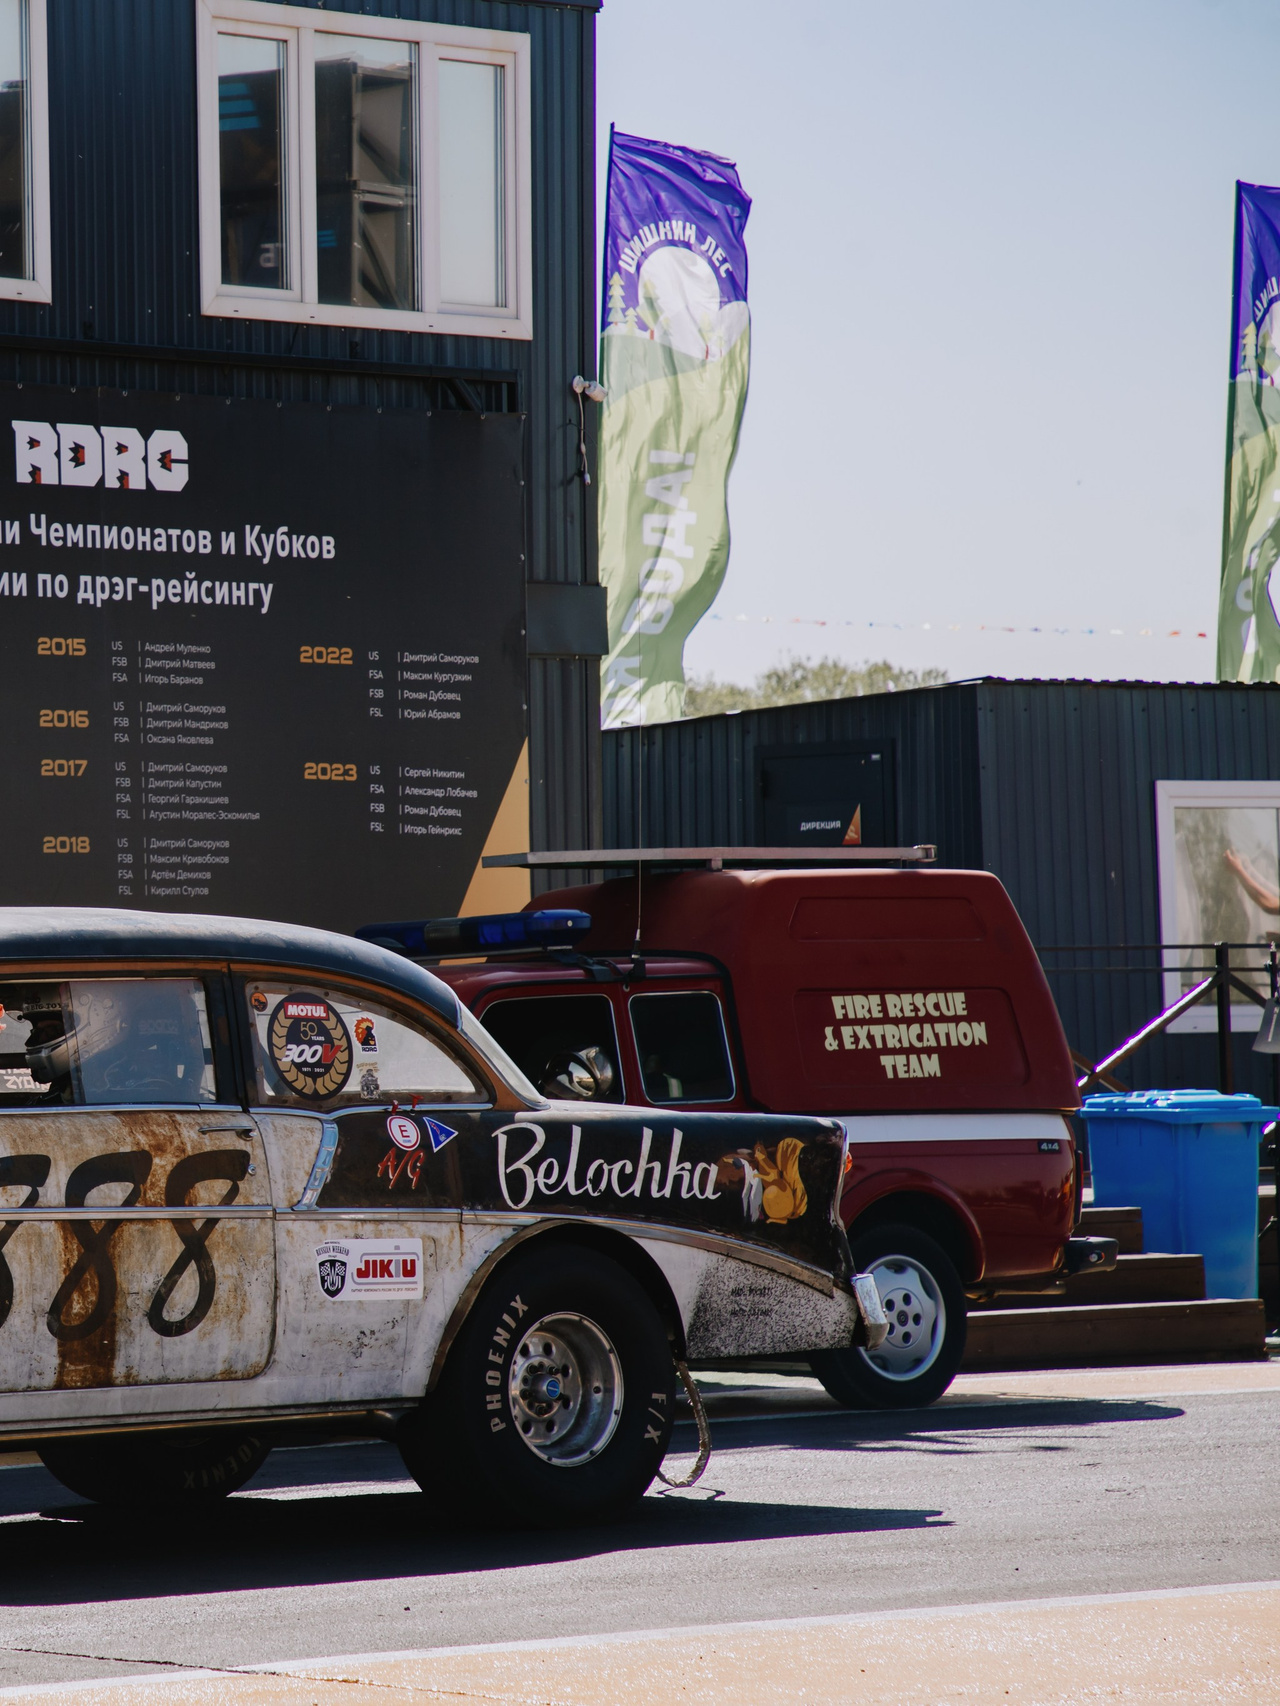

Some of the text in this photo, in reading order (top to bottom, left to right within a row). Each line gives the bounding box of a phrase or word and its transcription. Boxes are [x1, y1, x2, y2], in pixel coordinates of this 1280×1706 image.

[618, 220, 733, 278] ШИШКИН ЛЕС
[11, 419, 189, 492] RDRC
[30, 514, 212, 553] Чемпионатов
[221, 531, 235, 554] и
[245, 525, 335, 564] Кубков
[38, 574, 68, 598] по
[77, 572, 273, 614] дрэг-рейсингу
[38, 637, 86, 655] 2015
[112, 641, 122, 650] US
[144, 642, 175, 653] Андрей
[300, 646, 353, 664] 2022
[369, 651, 379, 660] US
[403, 652, 479, 665] Дмитрий Саморуков
[112, 657, 127, 666] FSB
[145, 658, 216, 669] Дмитрий Матвеев
[113, 673, 127, 682] FSA
[145, 674, 203, 685] Игорь Баранов
[369, 670, 383, 679] FSA
[404, 671, 432, 680] Максим
[370, 689, 384, 698] FSB
[404, 690, 461, 701] Роман Дубовец
[146, 702, 226, 715] Дмитрий Саморуков
[370, 708, 383, 717] FSL
[404, 709, 461, 720] Юрий Абрамов
[40, 710, 89, 727] 2016
[147, 718, 229, 730] Дмитрий Мандриков
[147, 734, 214, 744] Оксана Яковлева
[41, 759, 87, 776] 2017
[148, 762, 227, 774] Дмитрий Саморуков
[304, 763, 357, 781] 2023
[370, 766, 380, 774] US
[404, 767, 465, 778] Сергей Никитин
[148, 778, 222, 790] Дмитрий Капустин
[370, 784, 384, 793] FSA
[405, 786, 477, 798] Александр Лобачев
[149, 794, 179, 805] Георгий
[370, 803, 385, 812] FSB
[405, 805, 462, 817] Роман Дубовец
[149, 810, 180, 821] Агустин
[371, 822, 384, 831] FSL
[404, 825, 427, 835] Игорь
[800, 820, 841, 831] ДИРЕКЦИЯ
[43, 837, 90, 853] 2018
[150, 838, 229, 850] Дмитрий Саморуков
[150, 855, 181, 863] Максим
[177, 870, 211, 880] Демихов
[151, 886, 209, 897] Кирилл Стулов
[287, 1004, 327, 1017] MOTUL
[831, 992, 968, 1020] FIRE RESCUE
[300, 1021, 318, 1040] 50
[824, 1021, 988, 1051] & EXTRICATION
[281, 1043, 344, 1064] 300V
[880, 1054, 941, 1079] TEAM
[398, 1125, 410, 1138] E
[491, 1122, 721, 1210] Belochka
[356, 1258, 416, 1279] JIKIU
[485, 1293, 529, 1434] PHOENIX
